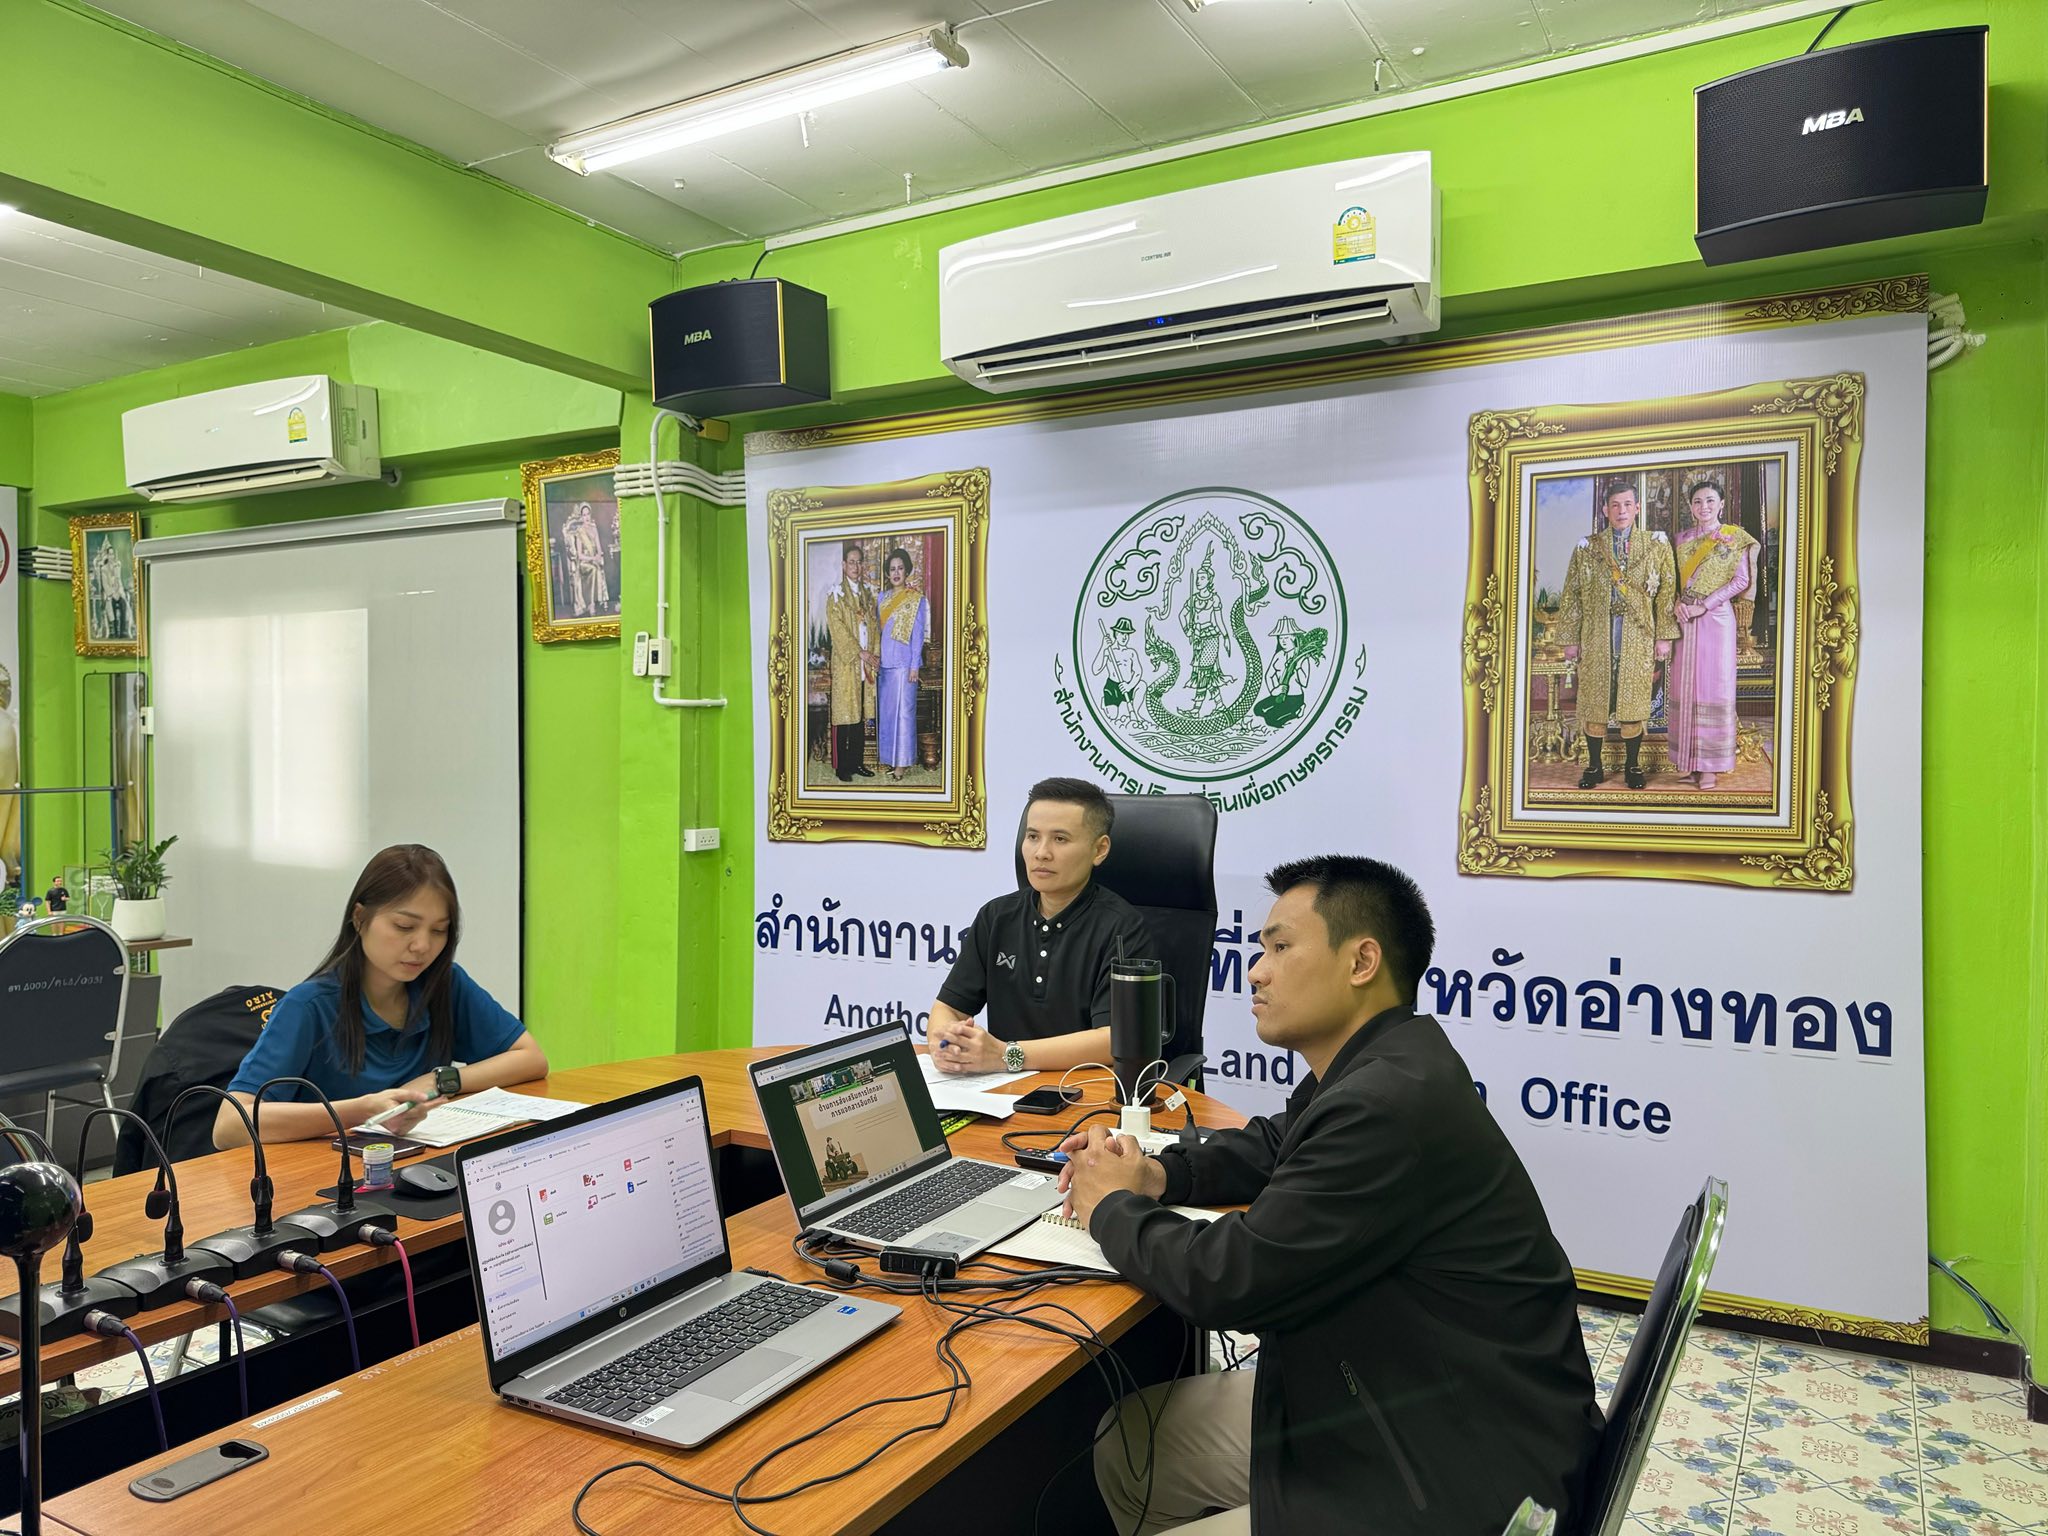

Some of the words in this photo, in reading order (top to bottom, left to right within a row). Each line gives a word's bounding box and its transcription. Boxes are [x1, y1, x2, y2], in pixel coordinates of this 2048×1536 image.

[1802, 107, 1865, 136] MBA
[684, 329, 712, 346] MBA
[1413, 946, 1893, 1058] หวัดอ่างทอง
[823, 994, 930, 1038] Angtho
[1521, 1076, 1672, 1135] Office
